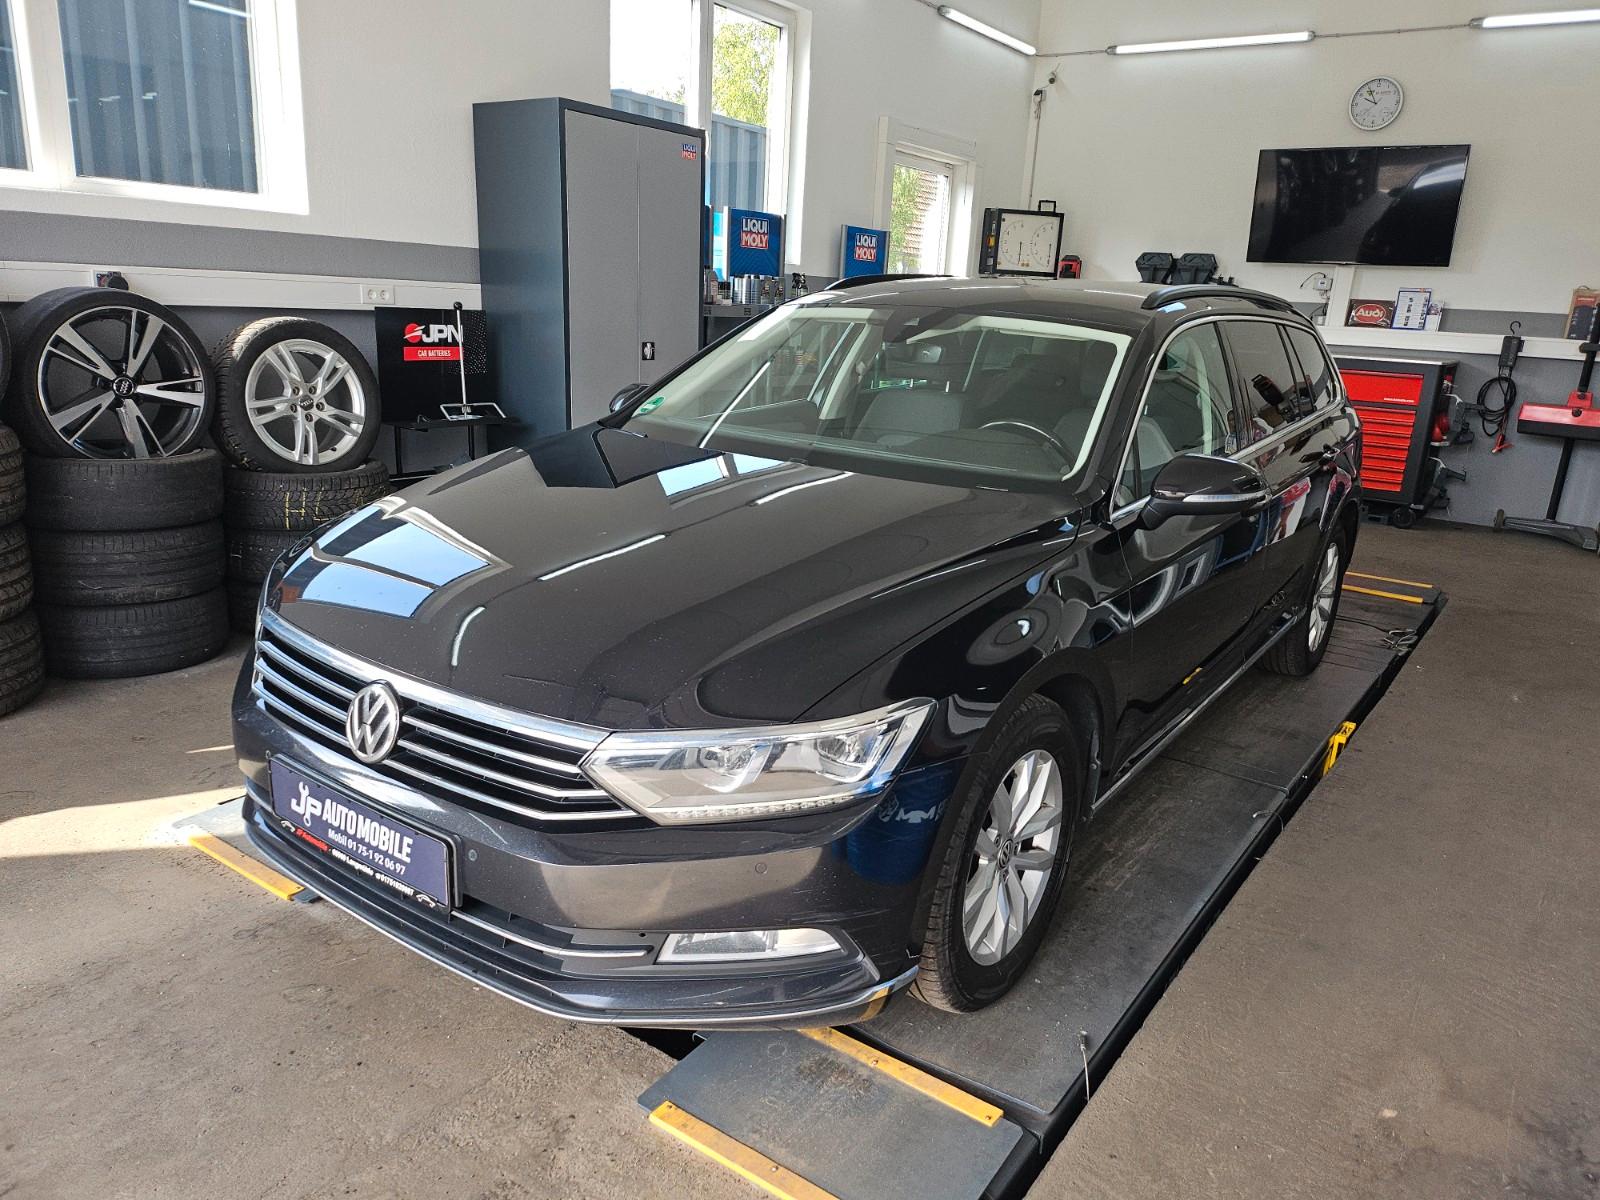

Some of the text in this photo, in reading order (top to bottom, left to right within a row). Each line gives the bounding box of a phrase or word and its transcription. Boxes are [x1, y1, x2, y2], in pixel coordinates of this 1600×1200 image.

[743, 218, 768, 233] LIQUI
[742, 232, 768, 247] MOLY
[856, 234, 876, 248] LIQUI
[855, 246, 876, 260] MOLY
[421, 324, 464, 343] JPN
[417, 349, 451, 357] CAR BATTERIES
[322, 798, 413, 863] AUTOMOBILE
[328, 829, 347, 846] Mobil
[348, 838, 357, 851] 01
[358, 845, 373, 859] 75-1
[374, 852, 384, 866] 92
[385, 857, 395, 871] 06
[395, 863, 406, 875] 97
